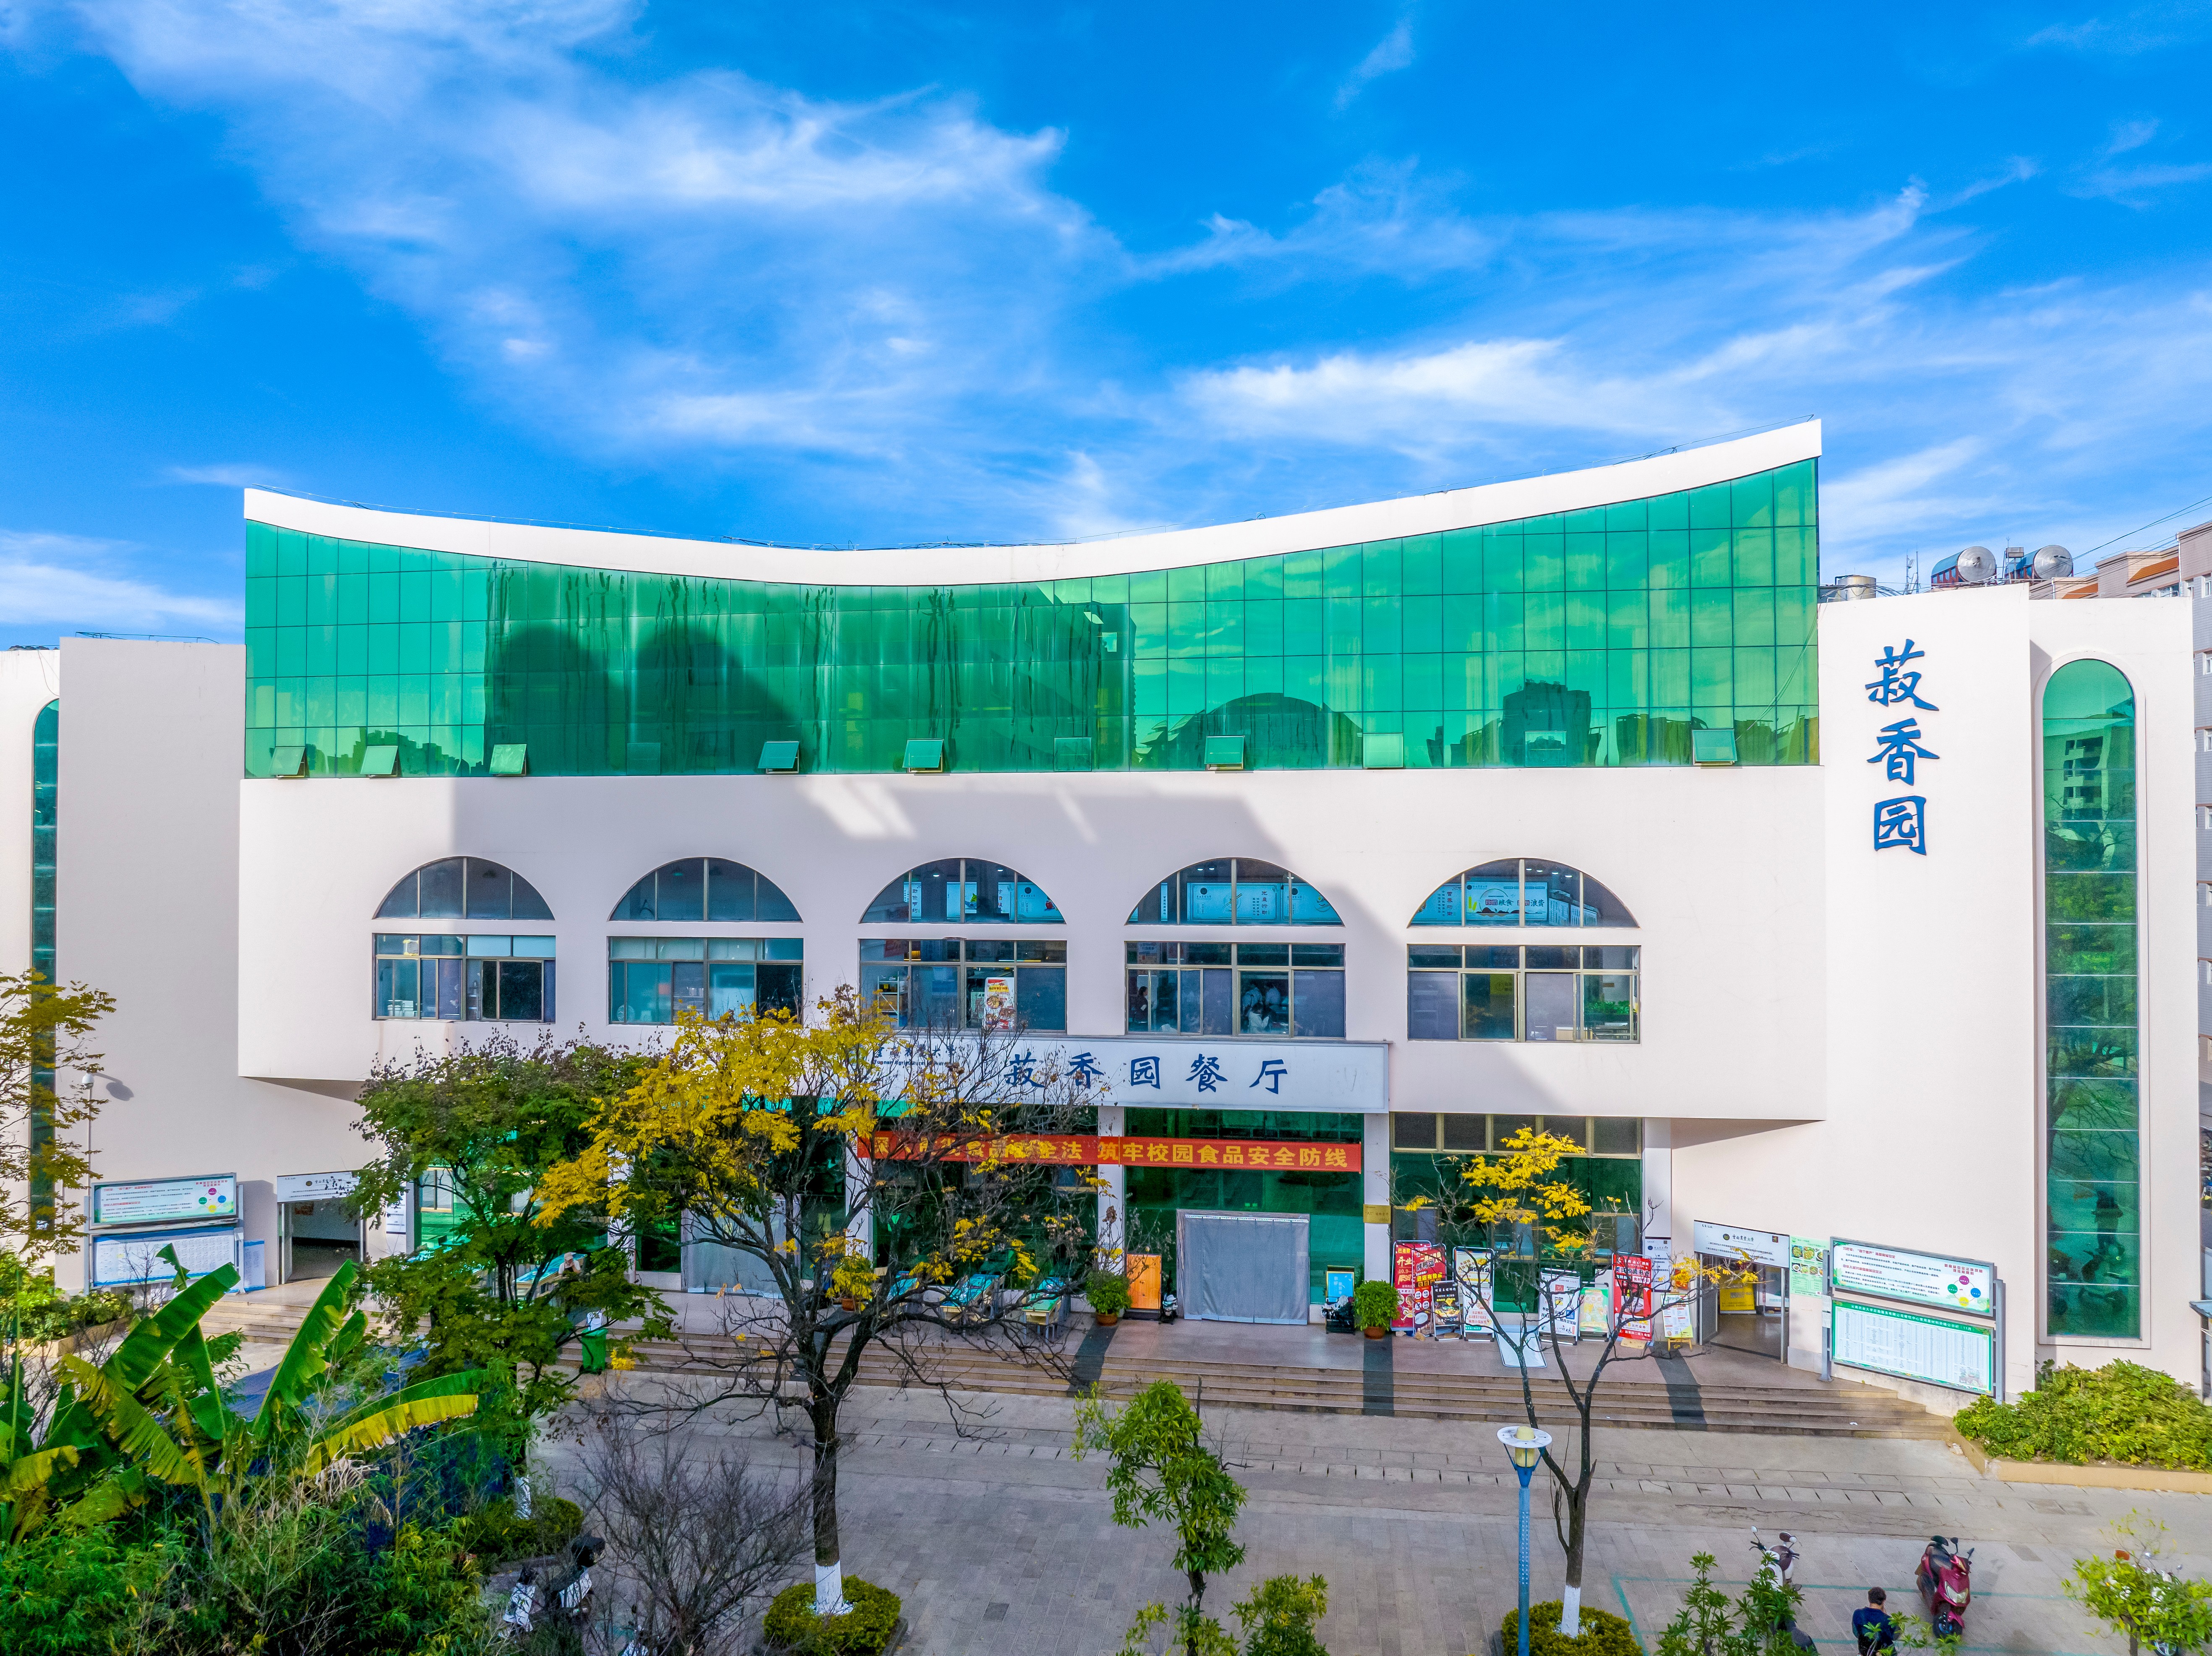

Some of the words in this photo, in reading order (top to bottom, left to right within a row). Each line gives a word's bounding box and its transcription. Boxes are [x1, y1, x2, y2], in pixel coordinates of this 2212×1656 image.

[1865, 639, 1940, 856] 菽香园
[1004, 1052, 1289, 1094] 菽香园餐厅
[1097, 1142, 1348, 1168] 筑牢校园食品安全防线
